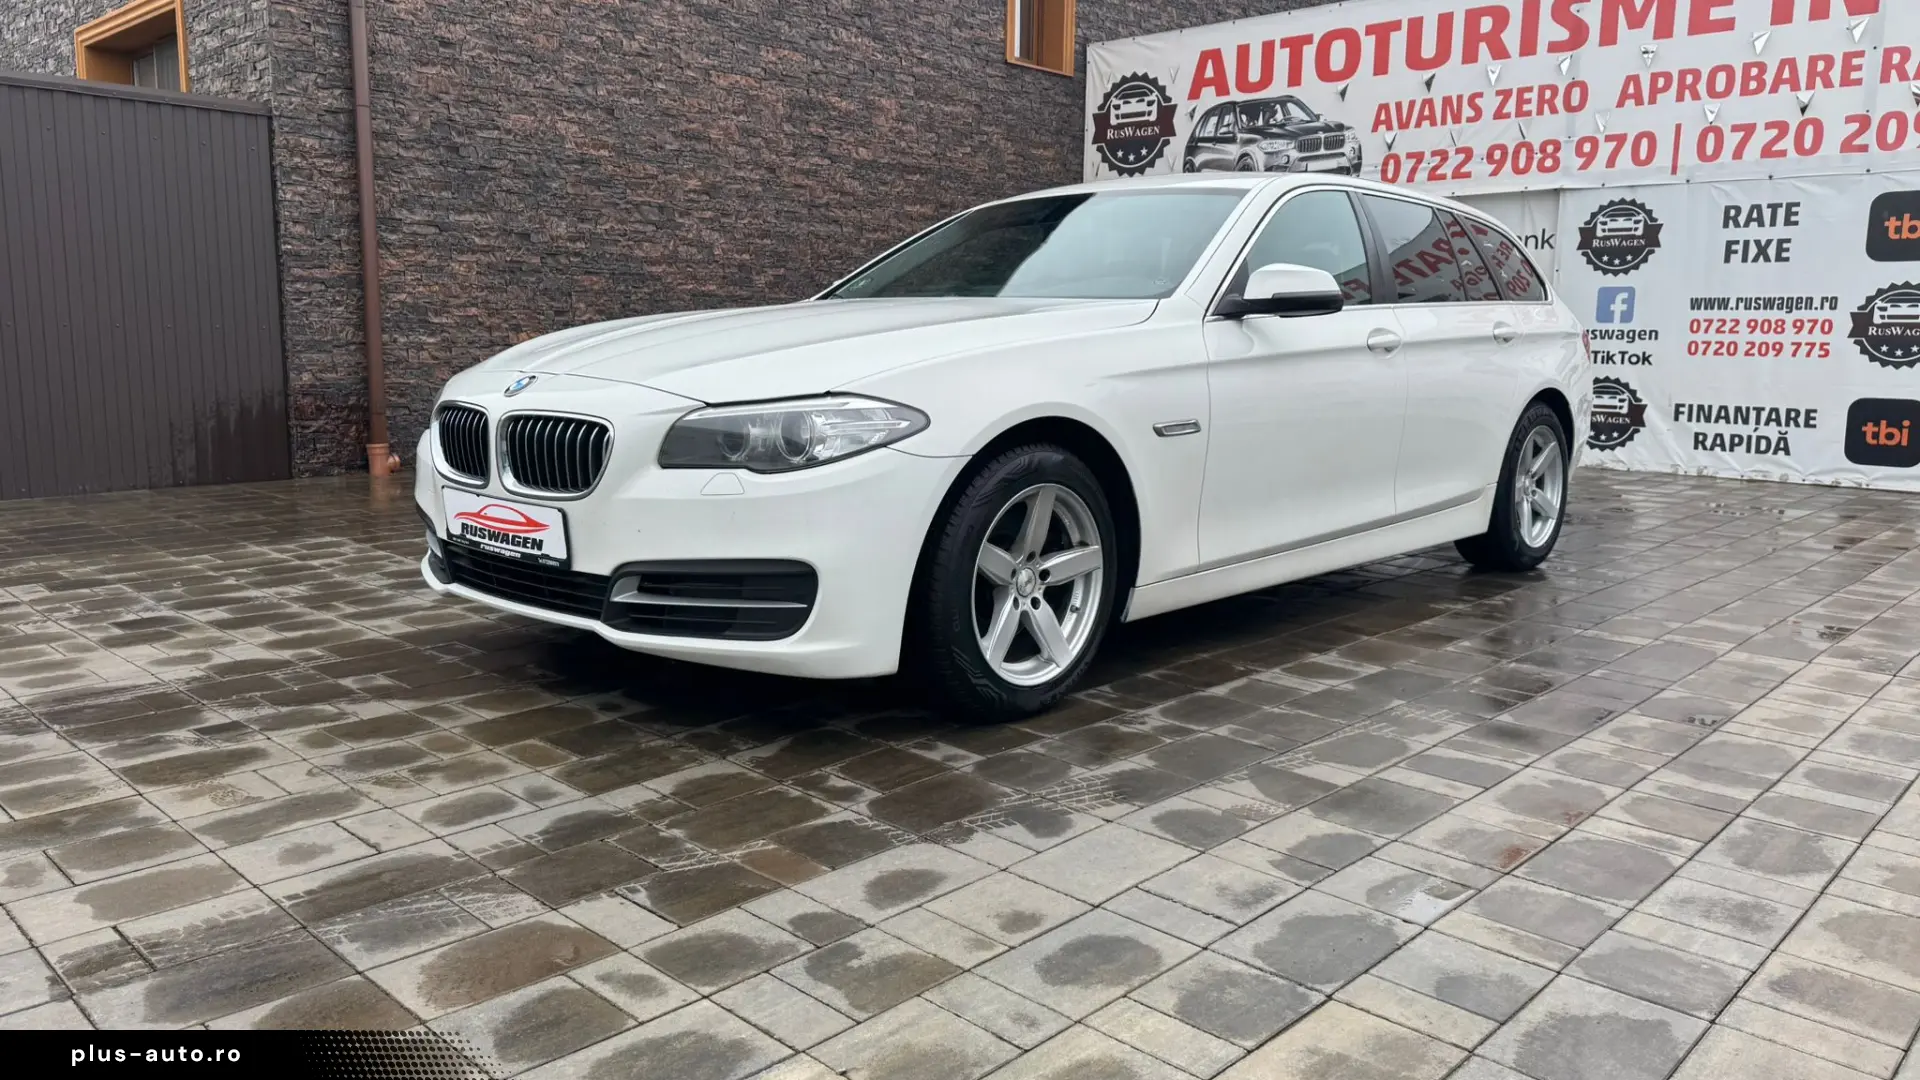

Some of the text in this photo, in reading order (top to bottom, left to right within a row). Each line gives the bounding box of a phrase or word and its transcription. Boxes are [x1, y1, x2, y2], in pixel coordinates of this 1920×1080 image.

[1187, 0, 1736, 100] AUTOTURISME
[1371, 45, 1920, 132] AVANS ZERO APROBARE R
[1380, 145, 1474, 184] 0722
[1485, 138, 1562, 177] 908
[1574, 130, 1657, 171] 970
[1696, 117, 1824, 163] 0720
[1839, 110, 1920, 154] 20
[1722, 201, 1800, 229] RATE
[1516, 227, 1555, 250] nk
[1723, 238, 1792, 264] FIXE
[1690, 296, 1838, 314] www.ruswagen.ro
[1586, 329, 1659, 343] swagen
[1689, 318, 1834, 335] 0722 908 970
[1591, 350, 1653, 366] TikTok
[1687, 340, 1831, 358] 0720 209 775
[1693, 430, 1791, 456] RAPIDĂ
[1862, 420, 1911, 446] tbi
[460, 522, 544, 552] RUSWAGEN
[480, 543, 521, 558] ruswagen
